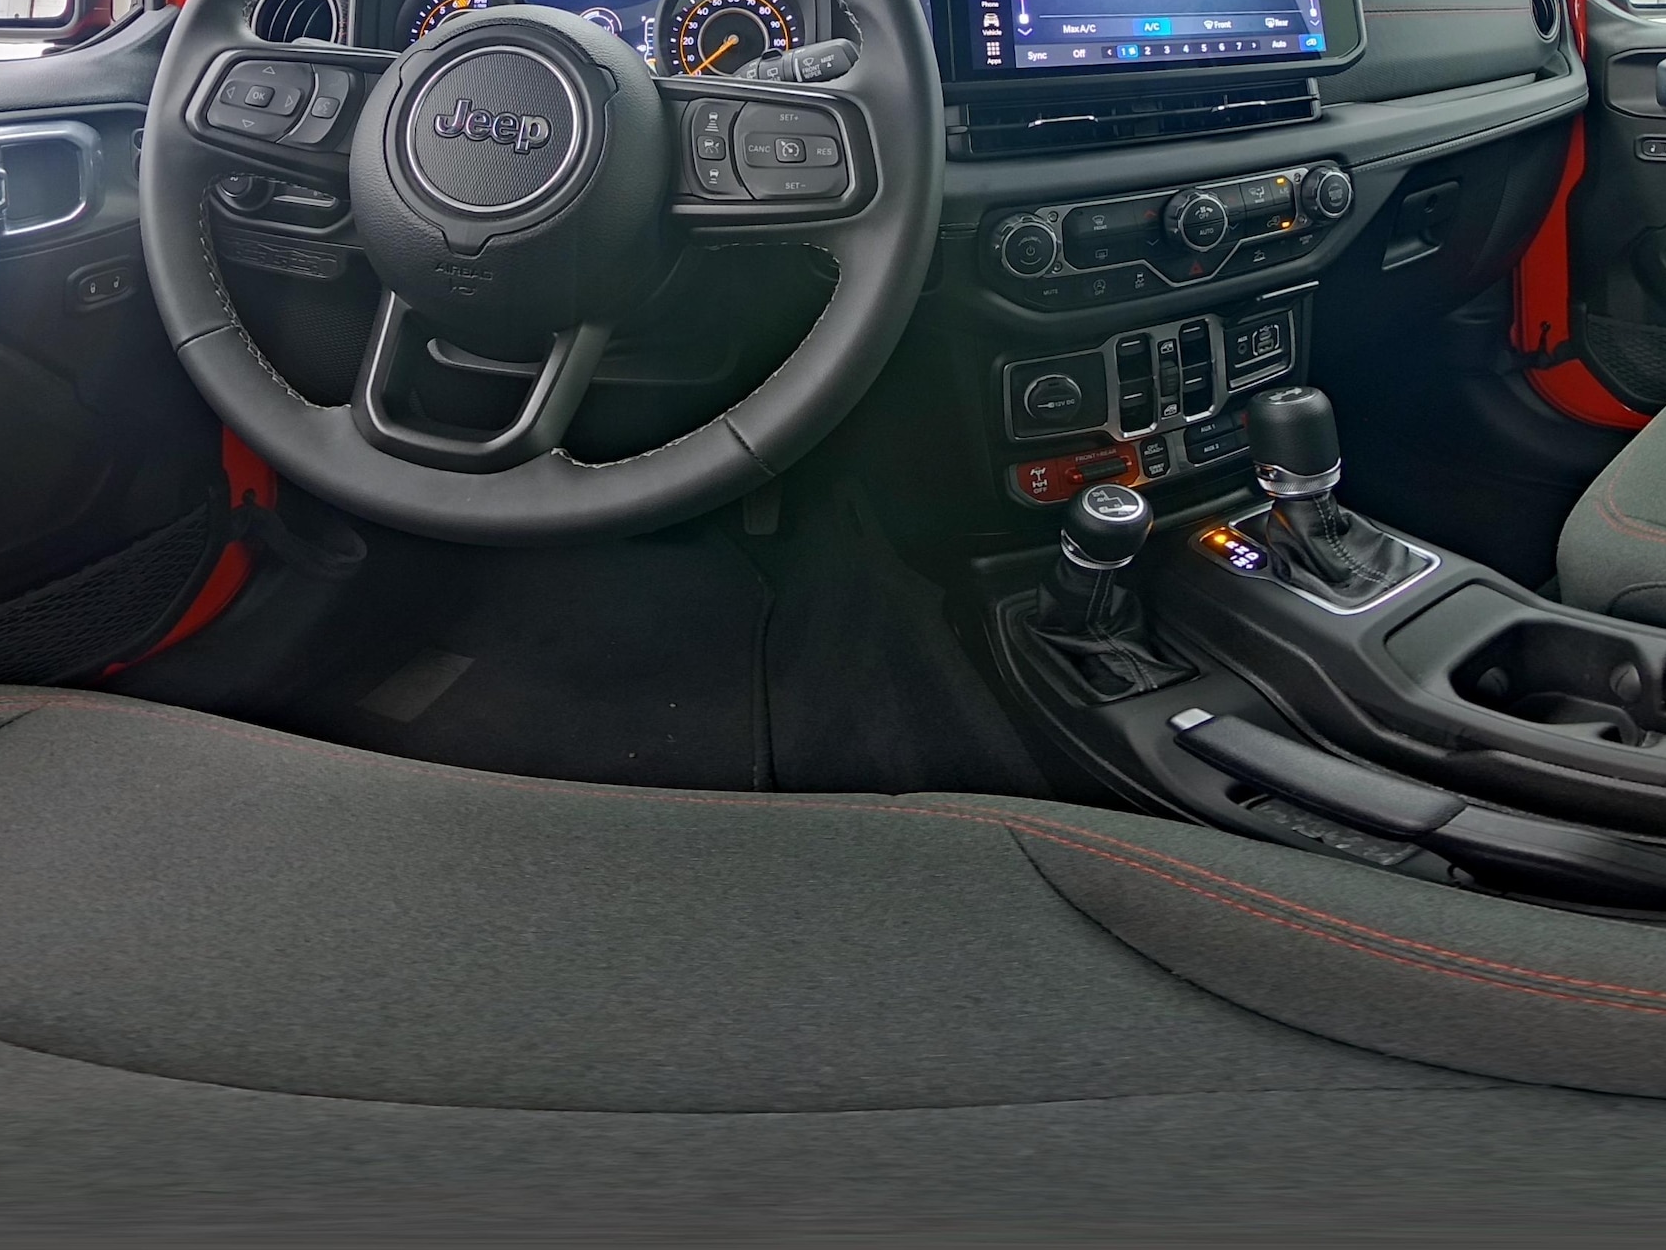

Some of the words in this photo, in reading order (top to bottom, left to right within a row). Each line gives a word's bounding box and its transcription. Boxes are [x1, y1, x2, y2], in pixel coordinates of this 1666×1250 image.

[981, 0, 1000, 8] Phone
[439, 6, 446, 15] 5
[697, 7, 709, 16] 40
[759, 6, 771, 16] 80
[688, 21, 699, 30] 30
[770, 20, 781, 29] 90
[1144, 22, 1160, 31] A/C
[1214, 20, 1232, 29] Front
[982, 28, 1002, 36] Vehicle
[683, 36, 694, 46] 20
[773, 38, 786, 47] 100
[1236, 41, 1242, 50] 7
[1271, 40, 1287, 49] Auto
[1144, 46, 1151, 55] 2
[1164, 45, 1171, 54] 3
[1183, 44, 1190, 53] 4
[1201, 43, 1208, 52] 5
[1219, 42, 1225, 51] 6
[687, 54, 695, 63] 10
[1027, 51, 1048, 61] Sync
[1073, 49, 1086, 59] Off
[987, 57, 1002, 65] Apps
[802, 64, 820, 74] FRONT
[252, 91, 265, 101] OK
[435, 99, 552, 154] Jeep
[748, 144, 771, 154] CANC
[816, 147, 832, 156] RES
[1198, 212, 1210, 220] OFF
[1199, 227, 1215, 236] AUTO
[1043, 288, 1059, 296] MUTE
[1200, 425, 1211, 433] AUX
[1033, 486, 1048, 495] OFF
[1245, 551, 1260, 561] D
